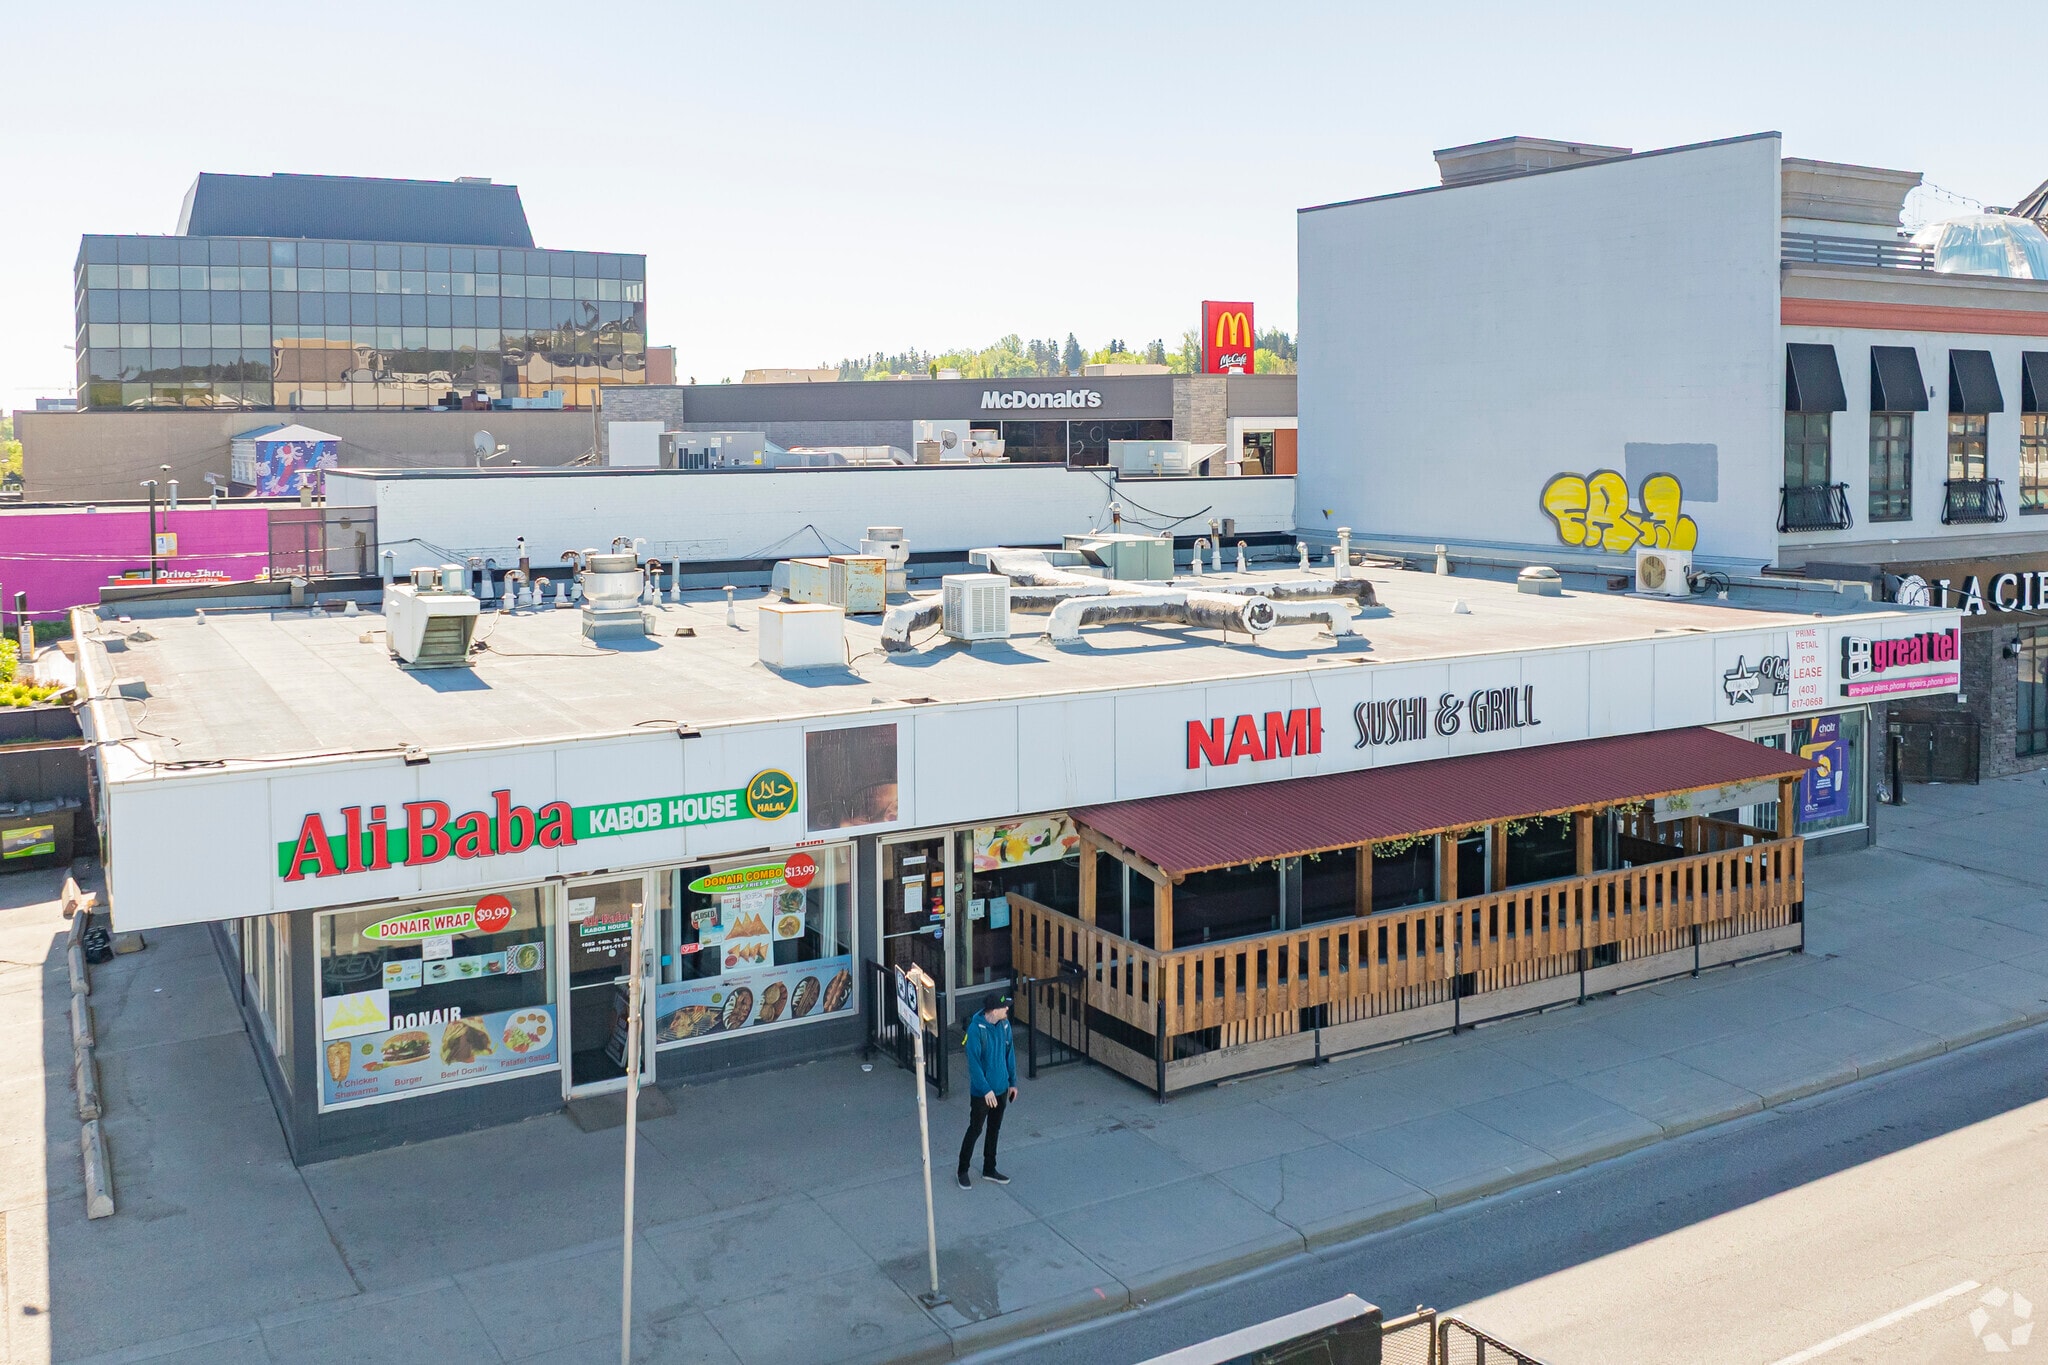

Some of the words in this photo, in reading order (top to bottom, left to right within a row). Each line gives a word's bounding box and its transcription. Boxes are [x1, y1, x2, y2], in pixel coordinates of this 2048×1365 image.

[980, 389, 1101, 409] McDonald's
[160, 569, 224, 579] Drive-Thru
[1995, 571, 2048, 613] CIE
[1795, 629, 1816, 638] PRIME
[1796, 641, 1819, 650] RETAIL
[1873, 632, 1930, 673] great
[1932, 628, 1959, 663] tel
[1801, 655, 1816, 664] FOR
[1793, 667, 1823, 679] LEASE
[1775, 682, 1788, 695] Ha
[1798, 684, 1817, 696] (403)
[1850, 685, 1874, 697] pre-paid
[1187, 707, 1322, 769] NAMI
[1354, 697, 1428, 749] SUSHI
[1435, 693, 1464, 737] &
[1469, 684, 1542, 734] GRILL
[752, 780, 792, 801] حلال
[757, 802, 787, 813] HALAL
[284, 806, 392, 882] Ali
[403, 789, 577, 866] Baba
[589, 803, 662, 834] KABOB
[669, 794, 738, 824] HOUSE
[703, 873, 744, 888] DONAIR
[745, 868, 783, 883] COMBO
[784, 865, 816, 879] $13.99
[476, 906, 510, 922] $9.99
[693, 910, 715, 921] CLOSED
[380, 917, 430, 937] DONAIR
[434, 912, 471, 930] WRAP
[607, 922, 629, 930] HOUSE
[393, 1006, 462, 1031] DONAIR
[501, 1056, 528, 1067] Falafel
[440, 1069, 460, 1079] Beef
[461, 1065, 488, 1074] Donair
[344, 1076, 379, 1088] Chicken
[394, 1075, 423, 1087] Burger
[334, 1086, 379, 1099] Shawarma
